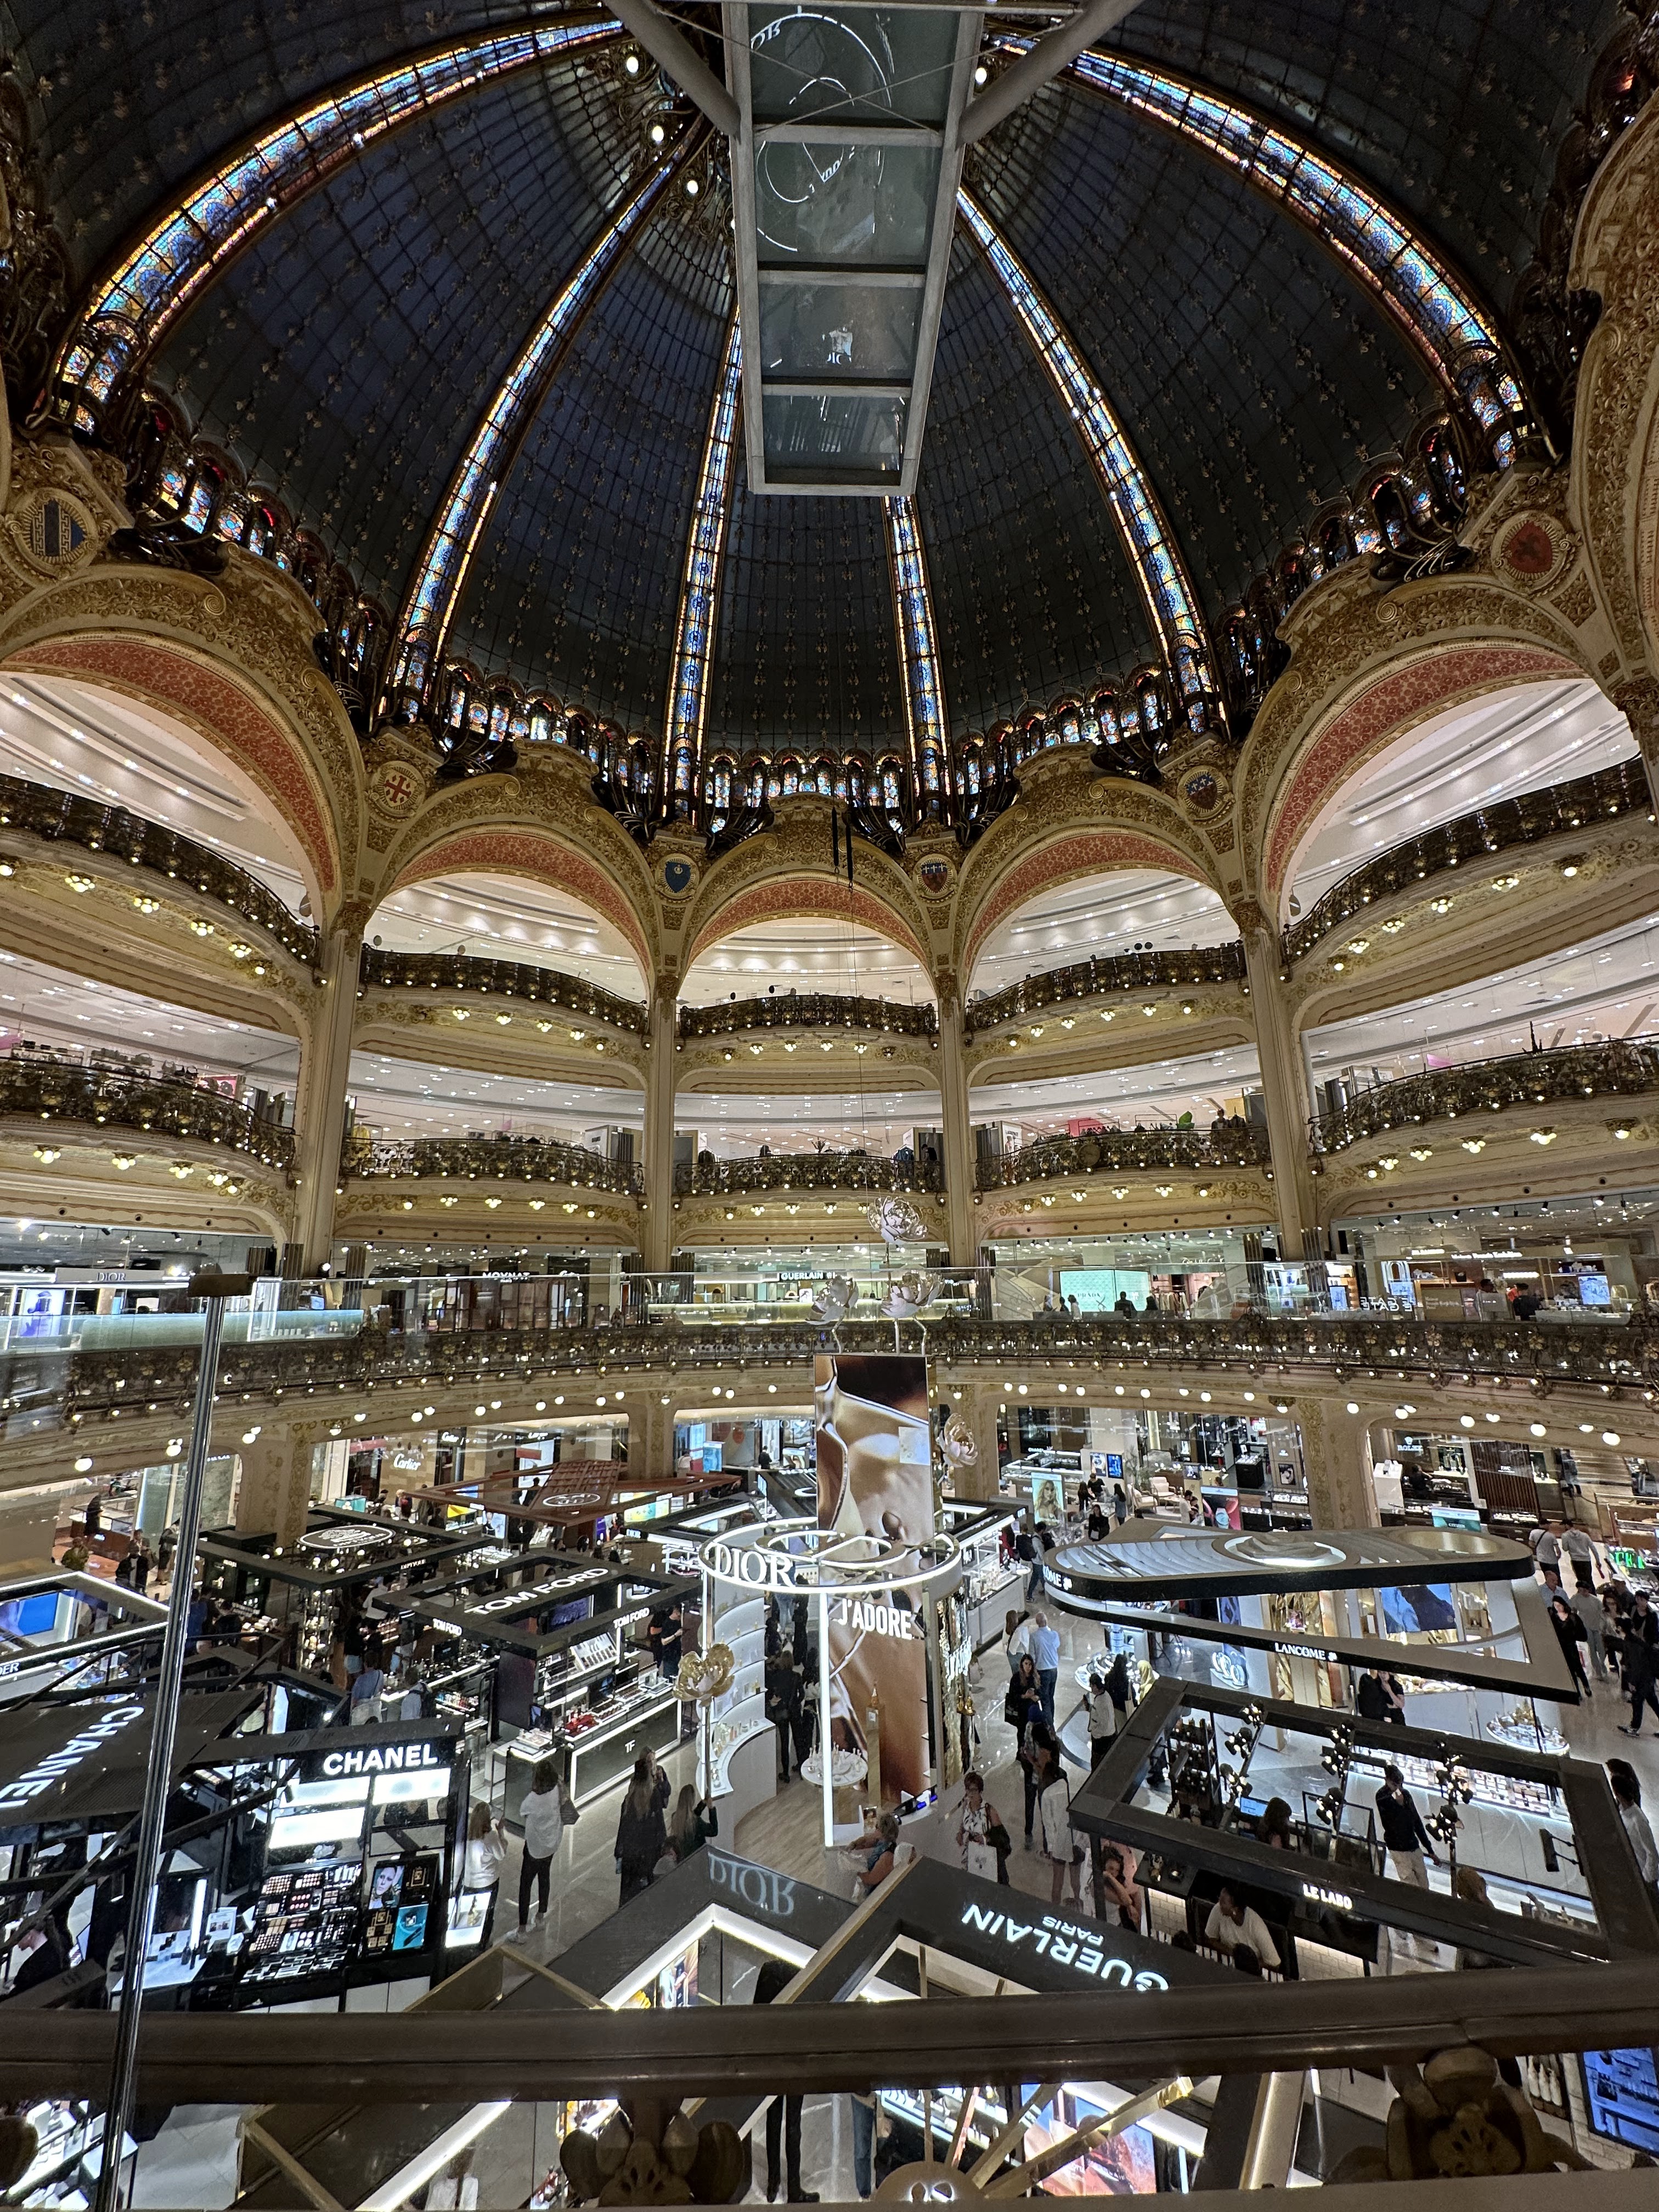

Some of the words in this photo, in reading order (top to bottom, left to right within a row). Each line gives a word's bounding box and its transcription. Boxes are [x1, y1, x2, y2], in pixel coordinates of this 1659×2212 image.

[97, 1272, 126, 1281] DIOR
[781, 1272, 823, 1280] GUERLAIN
[393, 1453, 421, 1471] Cartier
[713, 1542, 796, 1587] DIOR
[464, 1592, 538, 1615] TOM
[533, 1567, 609, 1594] FORD
[432, 1618, 446, 1631] TOM
[445, 1622, 462, 1635] FORD
[613, 1615, 631, 1629] TOM
[630, 1607, 650, 1624] FORD
[837, 1598, 913, 1640] J'ADORE
[323, 1743, 439, 1776] CHANEL
[624, 1739, 636, 1753] TF
[1303, 1883, 1320, 1900] LE
[1320, 1888, 1353, 1910] LABO
[1042, 1916, 1104, 1945] PARIS
[961, 1904, 1170, 1993] GUERLAIN
